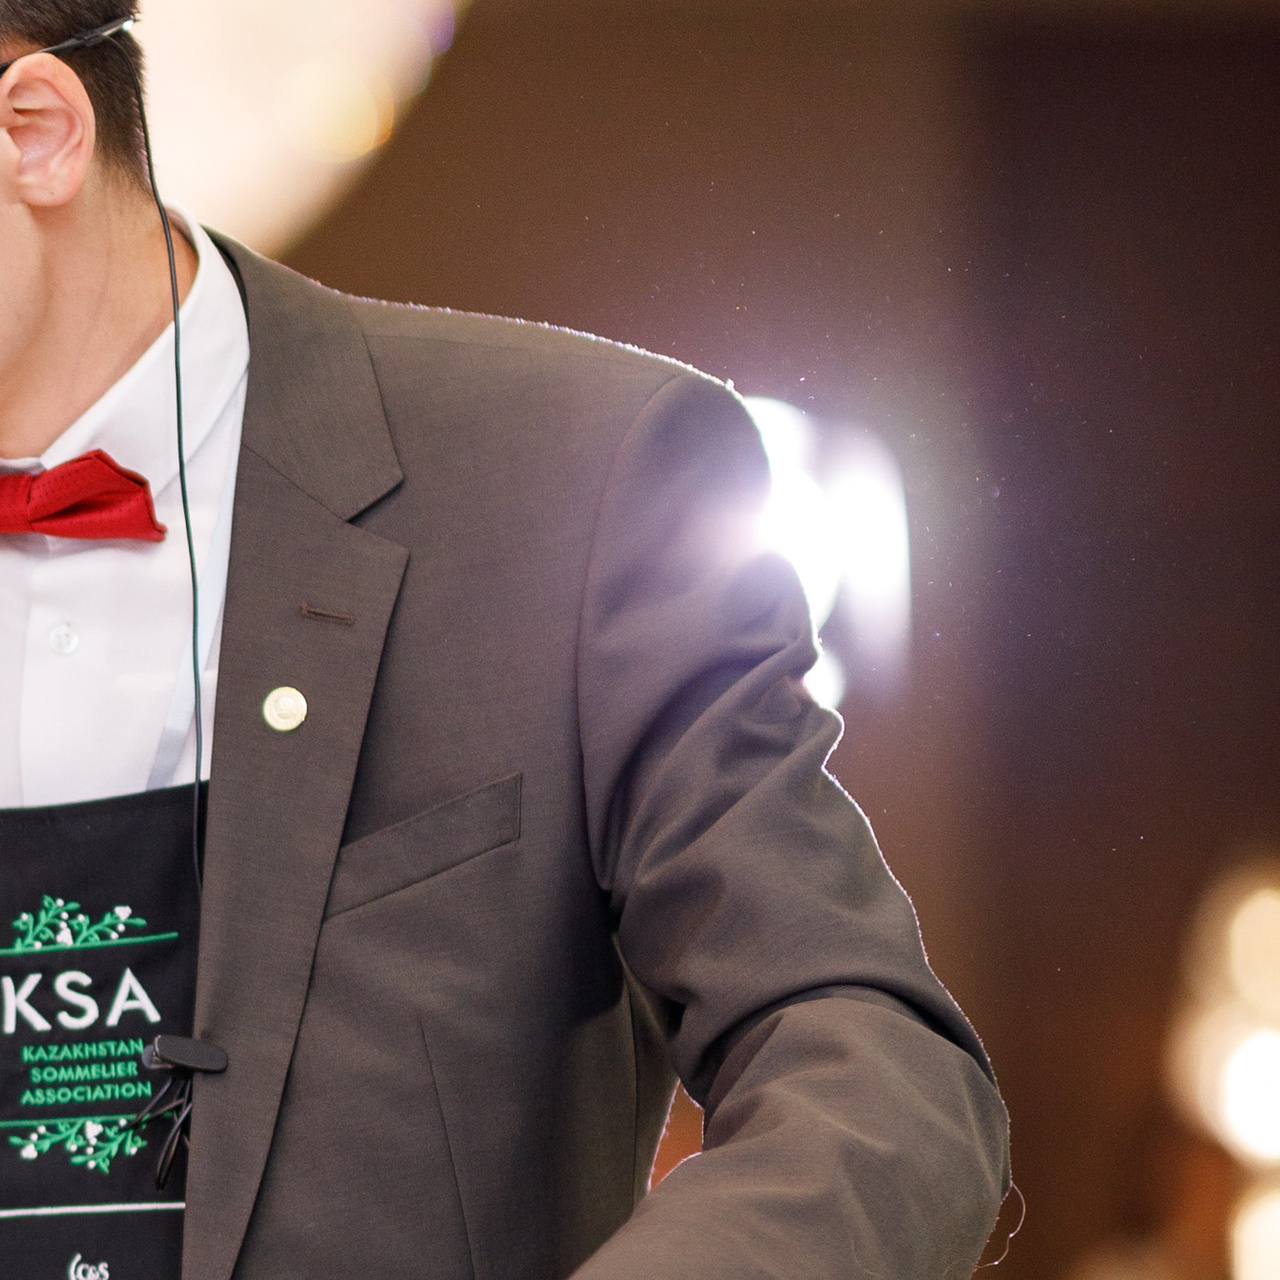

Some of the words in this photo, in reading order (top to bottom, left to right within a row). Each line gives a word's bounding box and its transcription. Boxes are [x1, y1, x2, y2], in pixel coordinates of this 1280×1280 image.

[1, 967, 162, 1034] KSA
[21, 1037, 144, 1062] KAZAKHSTAN
[29, 1060, 139, 1083] SOMMELIER
[20, 1080, 152, 1105] ASSOCIATION
